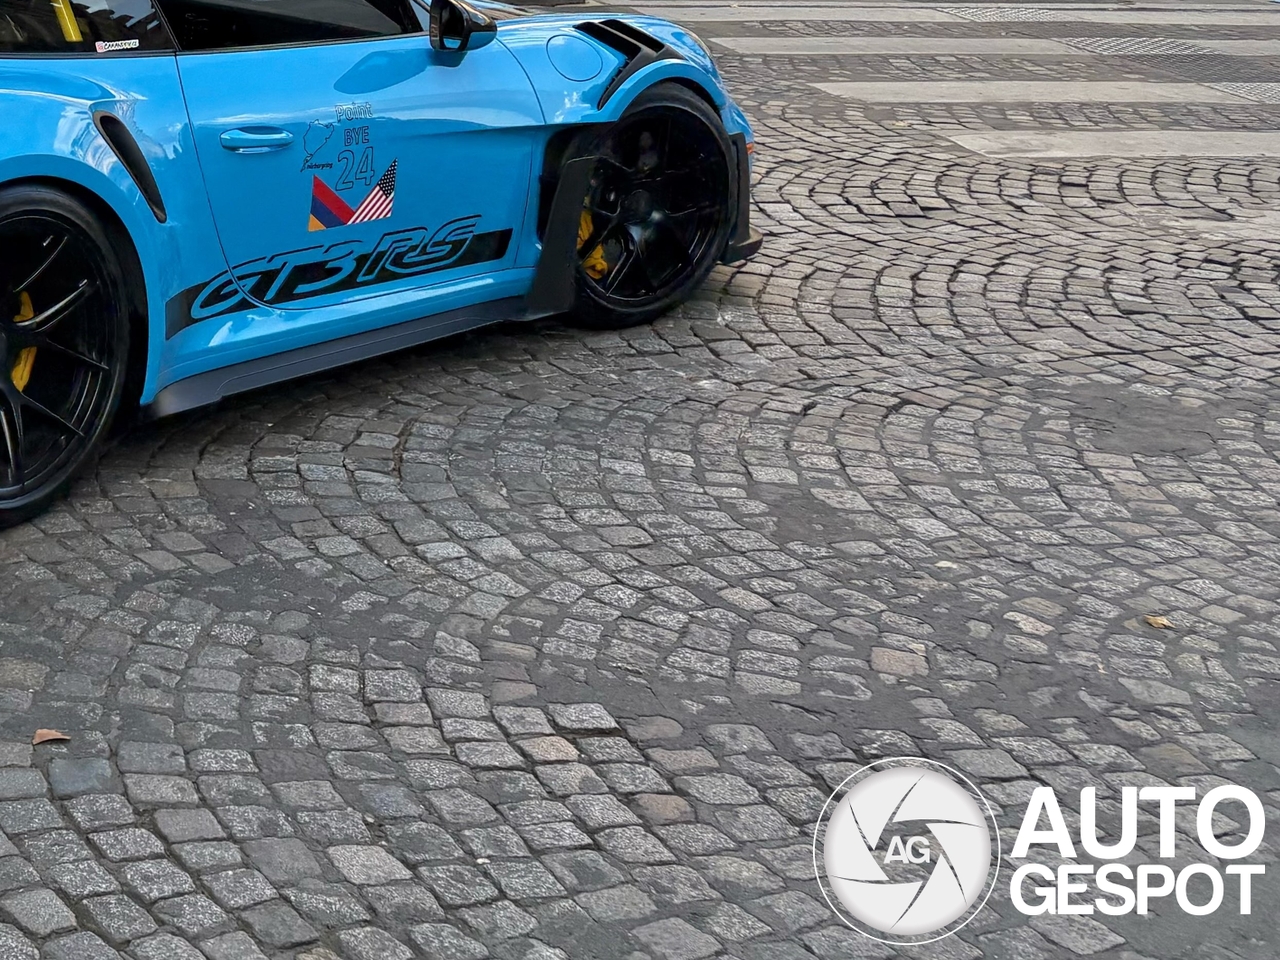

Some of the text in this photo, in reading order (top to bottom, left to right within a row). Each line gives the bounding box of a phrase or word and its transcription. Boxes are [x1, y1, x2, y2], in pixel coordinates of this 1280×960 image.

[334, 101, 374, 123] Point
[343, 126, 370, 146] BYE
[334, 146, 376, 192] 24
